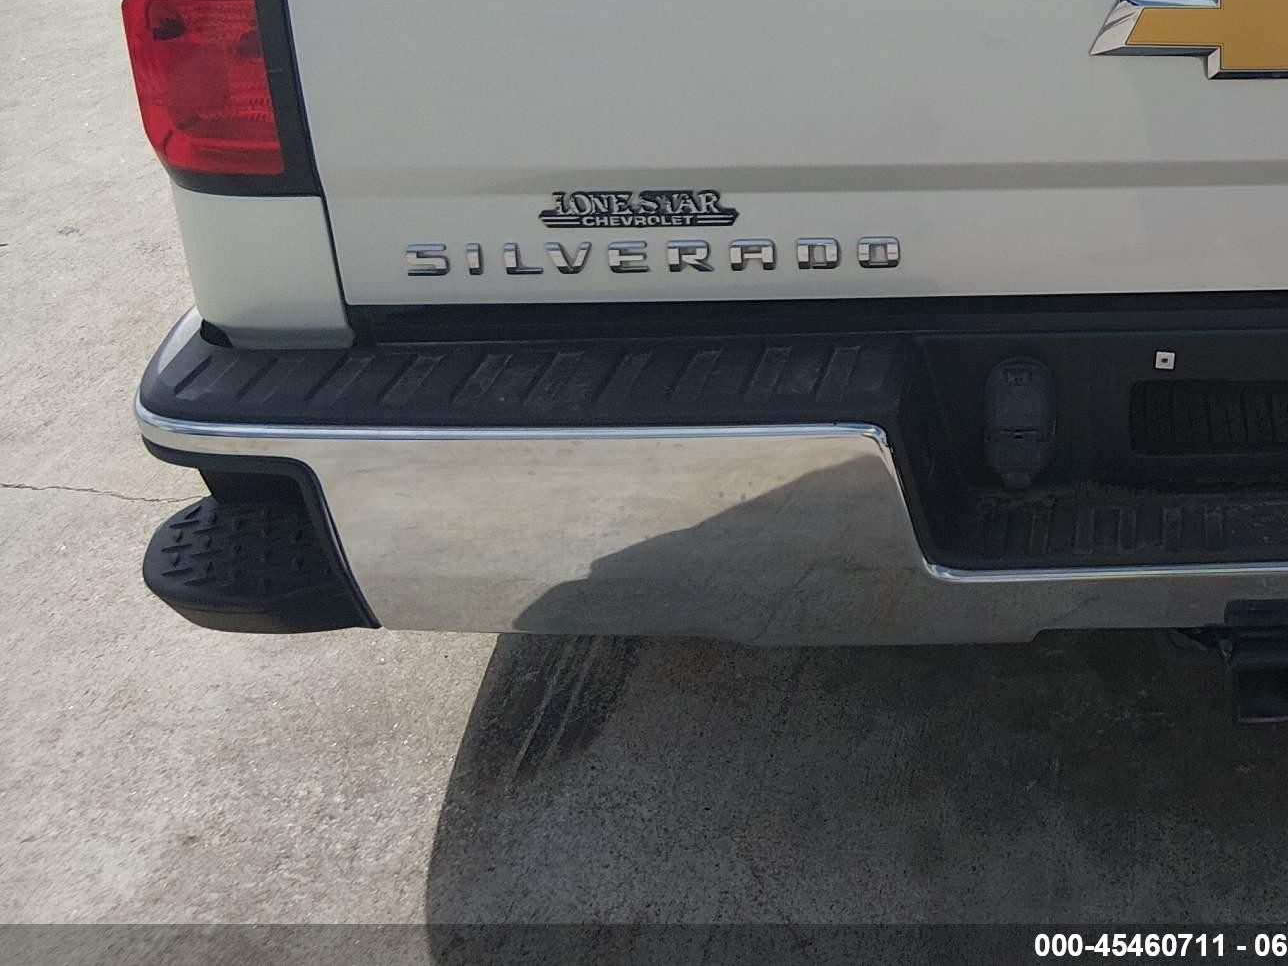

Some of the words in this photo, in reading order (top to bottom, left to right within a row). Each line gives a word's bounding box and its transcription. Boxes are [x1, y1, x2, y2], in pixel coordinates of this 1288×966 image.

[552, 191, 633, 215] LONE
[638, 190, 722, 214] STAR
[581, 215, 694, 227] CHEVROLET
[404, 235, 903, 276] SILVERADO
